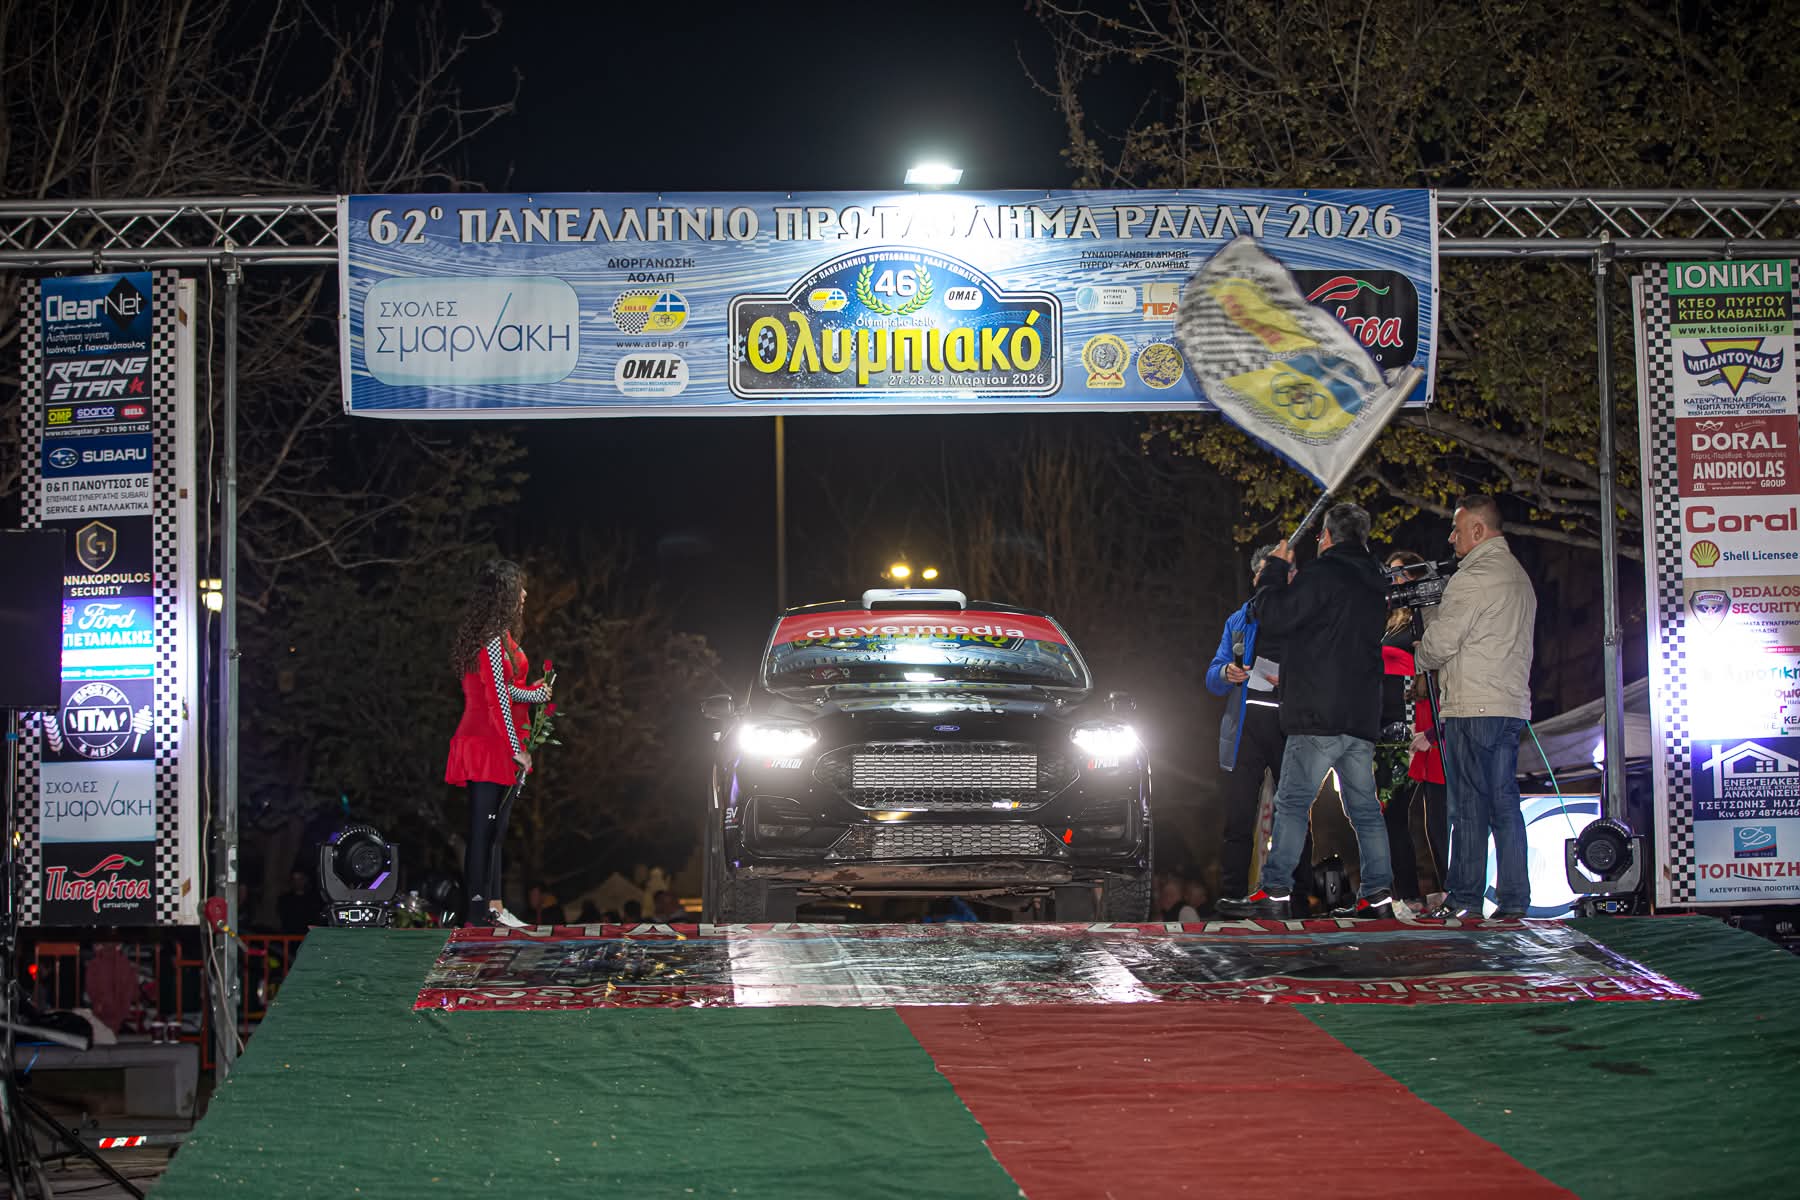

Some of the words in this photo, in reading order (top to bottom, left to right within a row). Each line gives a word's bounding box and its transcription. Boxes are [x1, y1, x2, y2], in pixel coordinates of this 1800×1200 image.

[459, 206, 760, 243] ΠΑΝΕΛΛΗΝΙΟ
[775, 205, 1101, 240] ΠΡΩΤΛΗΜΑ
[1113, 204, 1270, 240] ΡΑΛΛΥ
[1286, 204, 1403, 240] 2026
[1081, 250, 1154, 259] ΣΥΝΔΙΟΡΓΑΝΩΣΗ
[1155, 250, 1189, 259] ΔΗΜΩΝ
[607, 258, 696, 269] ΔΙΟΡΓΑΝΩΣΗ:
[1080, 260, 1113, 269] ΠΥΡΓΟΥ
[1122, 260, 1143, 269] ΑΡΧ.
[1144, 260, 1190, 269] ΟΛΥΜΠΙΑΣ
[627, 272, 675, 283] ΑΟΛΑΠ
[1675, 263, 1783, 289] ΙΟΝΙΚΗ
[873, 269, 920, 298] 46
[948, 290, 978, 301] ΟΜΑΕ
[45, 292, 142, 322] ClearNet
[1678, 297, 1716, 309] ΚΤΕΟ
[1726, 296, 1785, 307] ΠΥΡΓΟΥ
[380, 301, 458, 318] ΣΧΟΛΕΣ
[1679, 310, 1714, 321] ΚΤΕΟ
[1717, 308, 1786, 320] ΚΑΒΑΣΙΛΑ
[1678, 324, 1785, 336] www.kteoioniki.gr
[616, 340, 689, 350] www.aolap.gr
[747, 310, 1042, 386] Ολυμπιακό
[1688, 352, 1781, 372] ΜΠΑΝΤΟΥΝΑΣ
[46, 356, 149, 383] RACING
[622, 359, 681, 379] ΟΜΑΕ
[887, 373, 945, 386] 27-28-29
[949, 373, 1008, 387] Μαρτίου
[1012, 373, 1045, 386] 2026
[49, 379, 129, 401] STAR
[1684, 396, 1743, 405] ΚΑΤΕΨΥΓΜΕΝΑ
[1697, 403, 1721, 411] ΝΩΠΑ
[48, 412, 72, 422] OMP
[76, 406, 115, 417] sparco
[124, 408, 144, 416] BELL
[1691, 431, 1787, 452] DORAL
[82, 447, 147, 463] SUBARU
[1693, 460, 1785, 480] ANDRIOLAS
[72, 478, 132, 491] ΠΑΝΟΥΤΣΟΣ
[135, 477, 149, 488] ΟΕ
[1760, 479, 1786, 488] GROUP
[46, 505, 77, 515] SERVICE
[79, 504, 85, 513] &
[87, 502, 149, 513] ΑΝΤΑΛΛΑΚΤΙΚΑ
[1685, 505, 1798, 534] Coral
[1723, 551, 1750, 561] Shell
[1753, 550, 1799, 561] Licensee
[63, 573, 151, 586] NNAKOPOULOS
[70, 585, 123, 597] SECURITY
[1731, 585, 1800, 598] DEDALOS
[1731, 601, 1800, 614] SECURITY
[78, 603, 136, 630] Ford
[806, 624, 1025, 639] clevermedia
[45, 781, 98, 794] ΣΧΟΛΕΣ
[1723, 777, 1800, 787] ΕΝΕΡΓΕΙΑΚΕΣ
[1724, 789, 1800, 799] ΑΝΑΚΑΙΝΙΣΕΙΣ
[1699, 800, 1767, 810] ΤΣΕΤΣΩΝΗΣ
[1738, 810, 1756, 818] 697
[1758, 808, 1800, 817] 4876446
[46, 866, 151, 913] Πιπερίτσα
[1709, 886, 1761, 894] ΚΑΤΕΨΥΓΜΕΝΑ
